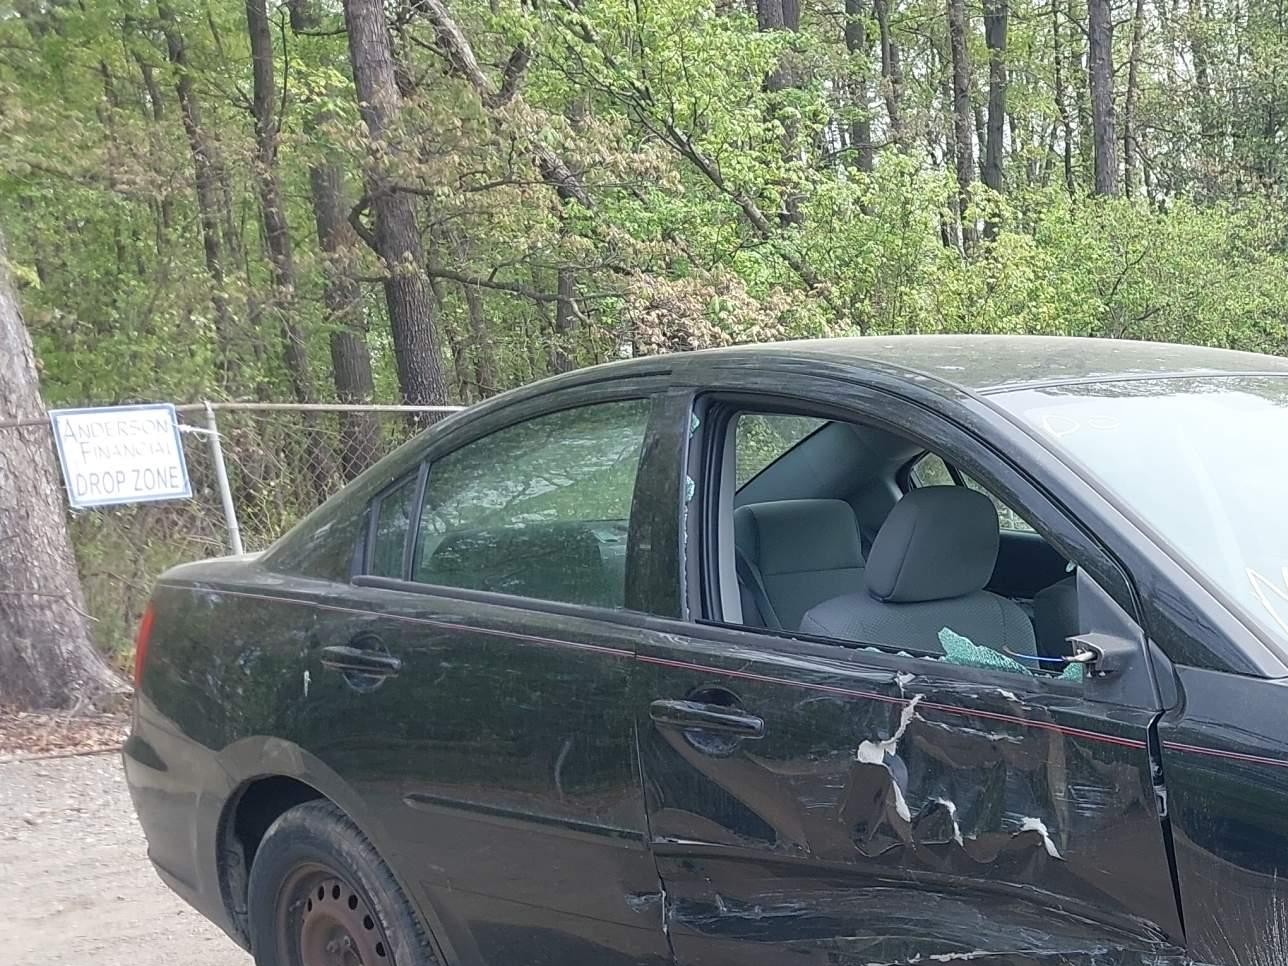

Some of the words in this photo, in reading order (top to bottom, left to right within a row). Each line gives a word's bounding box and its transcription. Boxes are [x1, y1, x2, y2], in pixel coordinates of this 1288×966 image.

[63, 417, 169, 442] ANDERSON
[80, 441, 173, 465] FINANCIAL
[76, 470, 126, 497] DROP
[131, 466, 180, 492] ZONE
